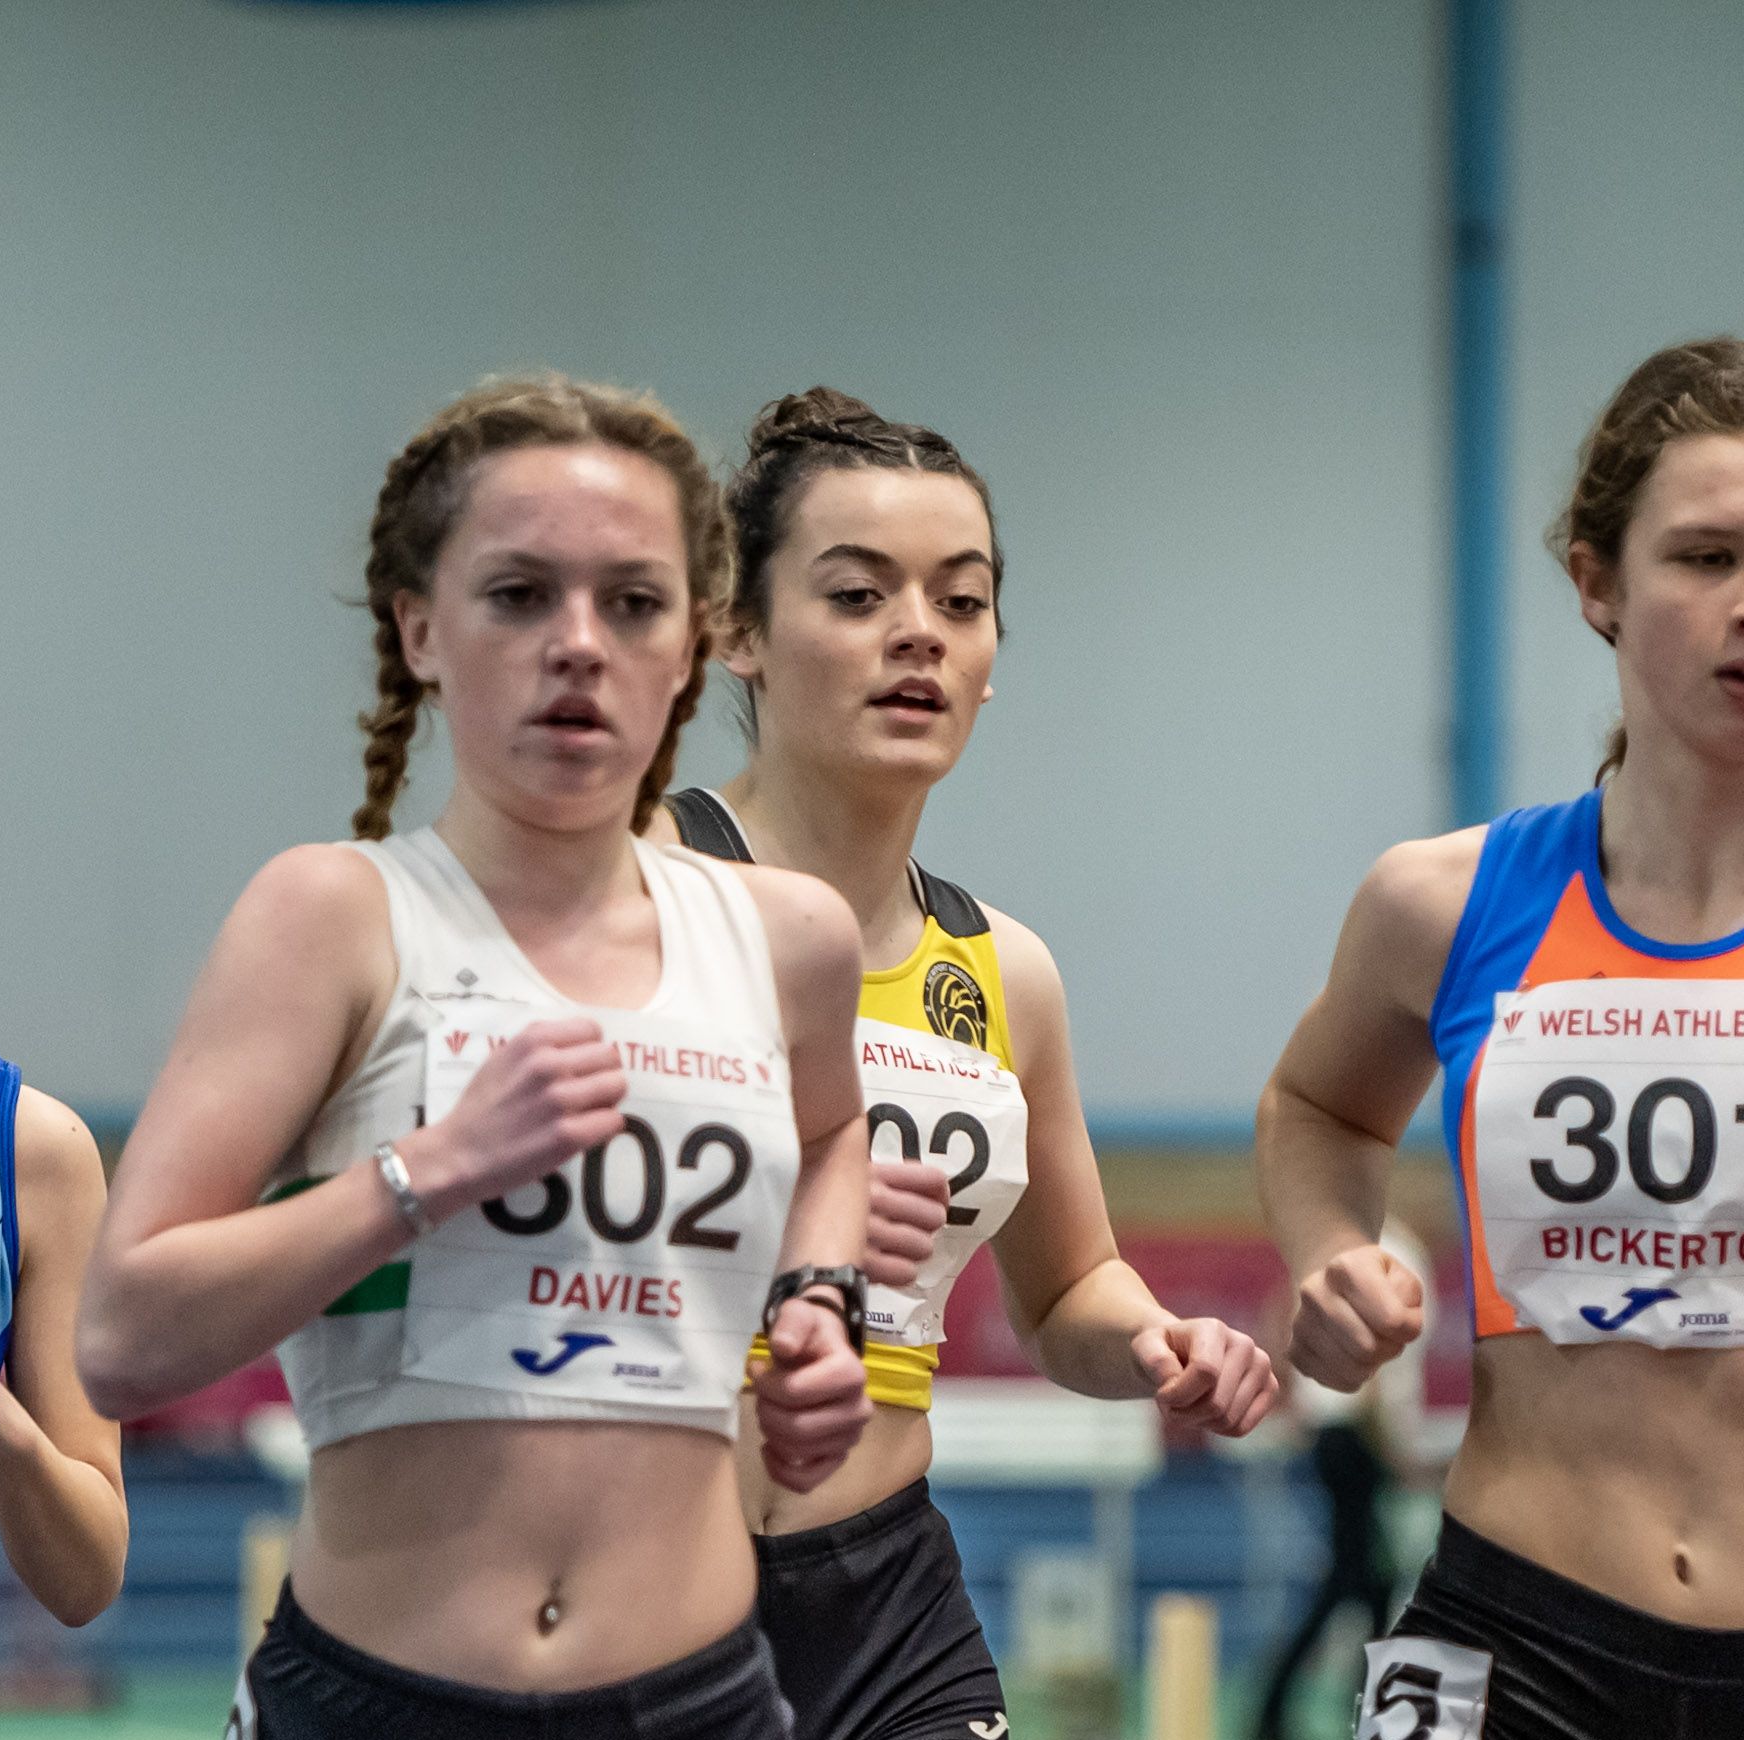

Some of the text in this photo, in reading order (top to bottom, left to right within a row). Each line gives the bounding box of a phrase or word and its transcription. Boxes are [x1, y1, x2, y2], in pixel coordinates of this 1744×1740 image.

[1539, 1009, 1642, 1037] WELSH
[611, 1041, 747, 1085] THLETICS
[528, 1265, 682, 1318] DAVIES
